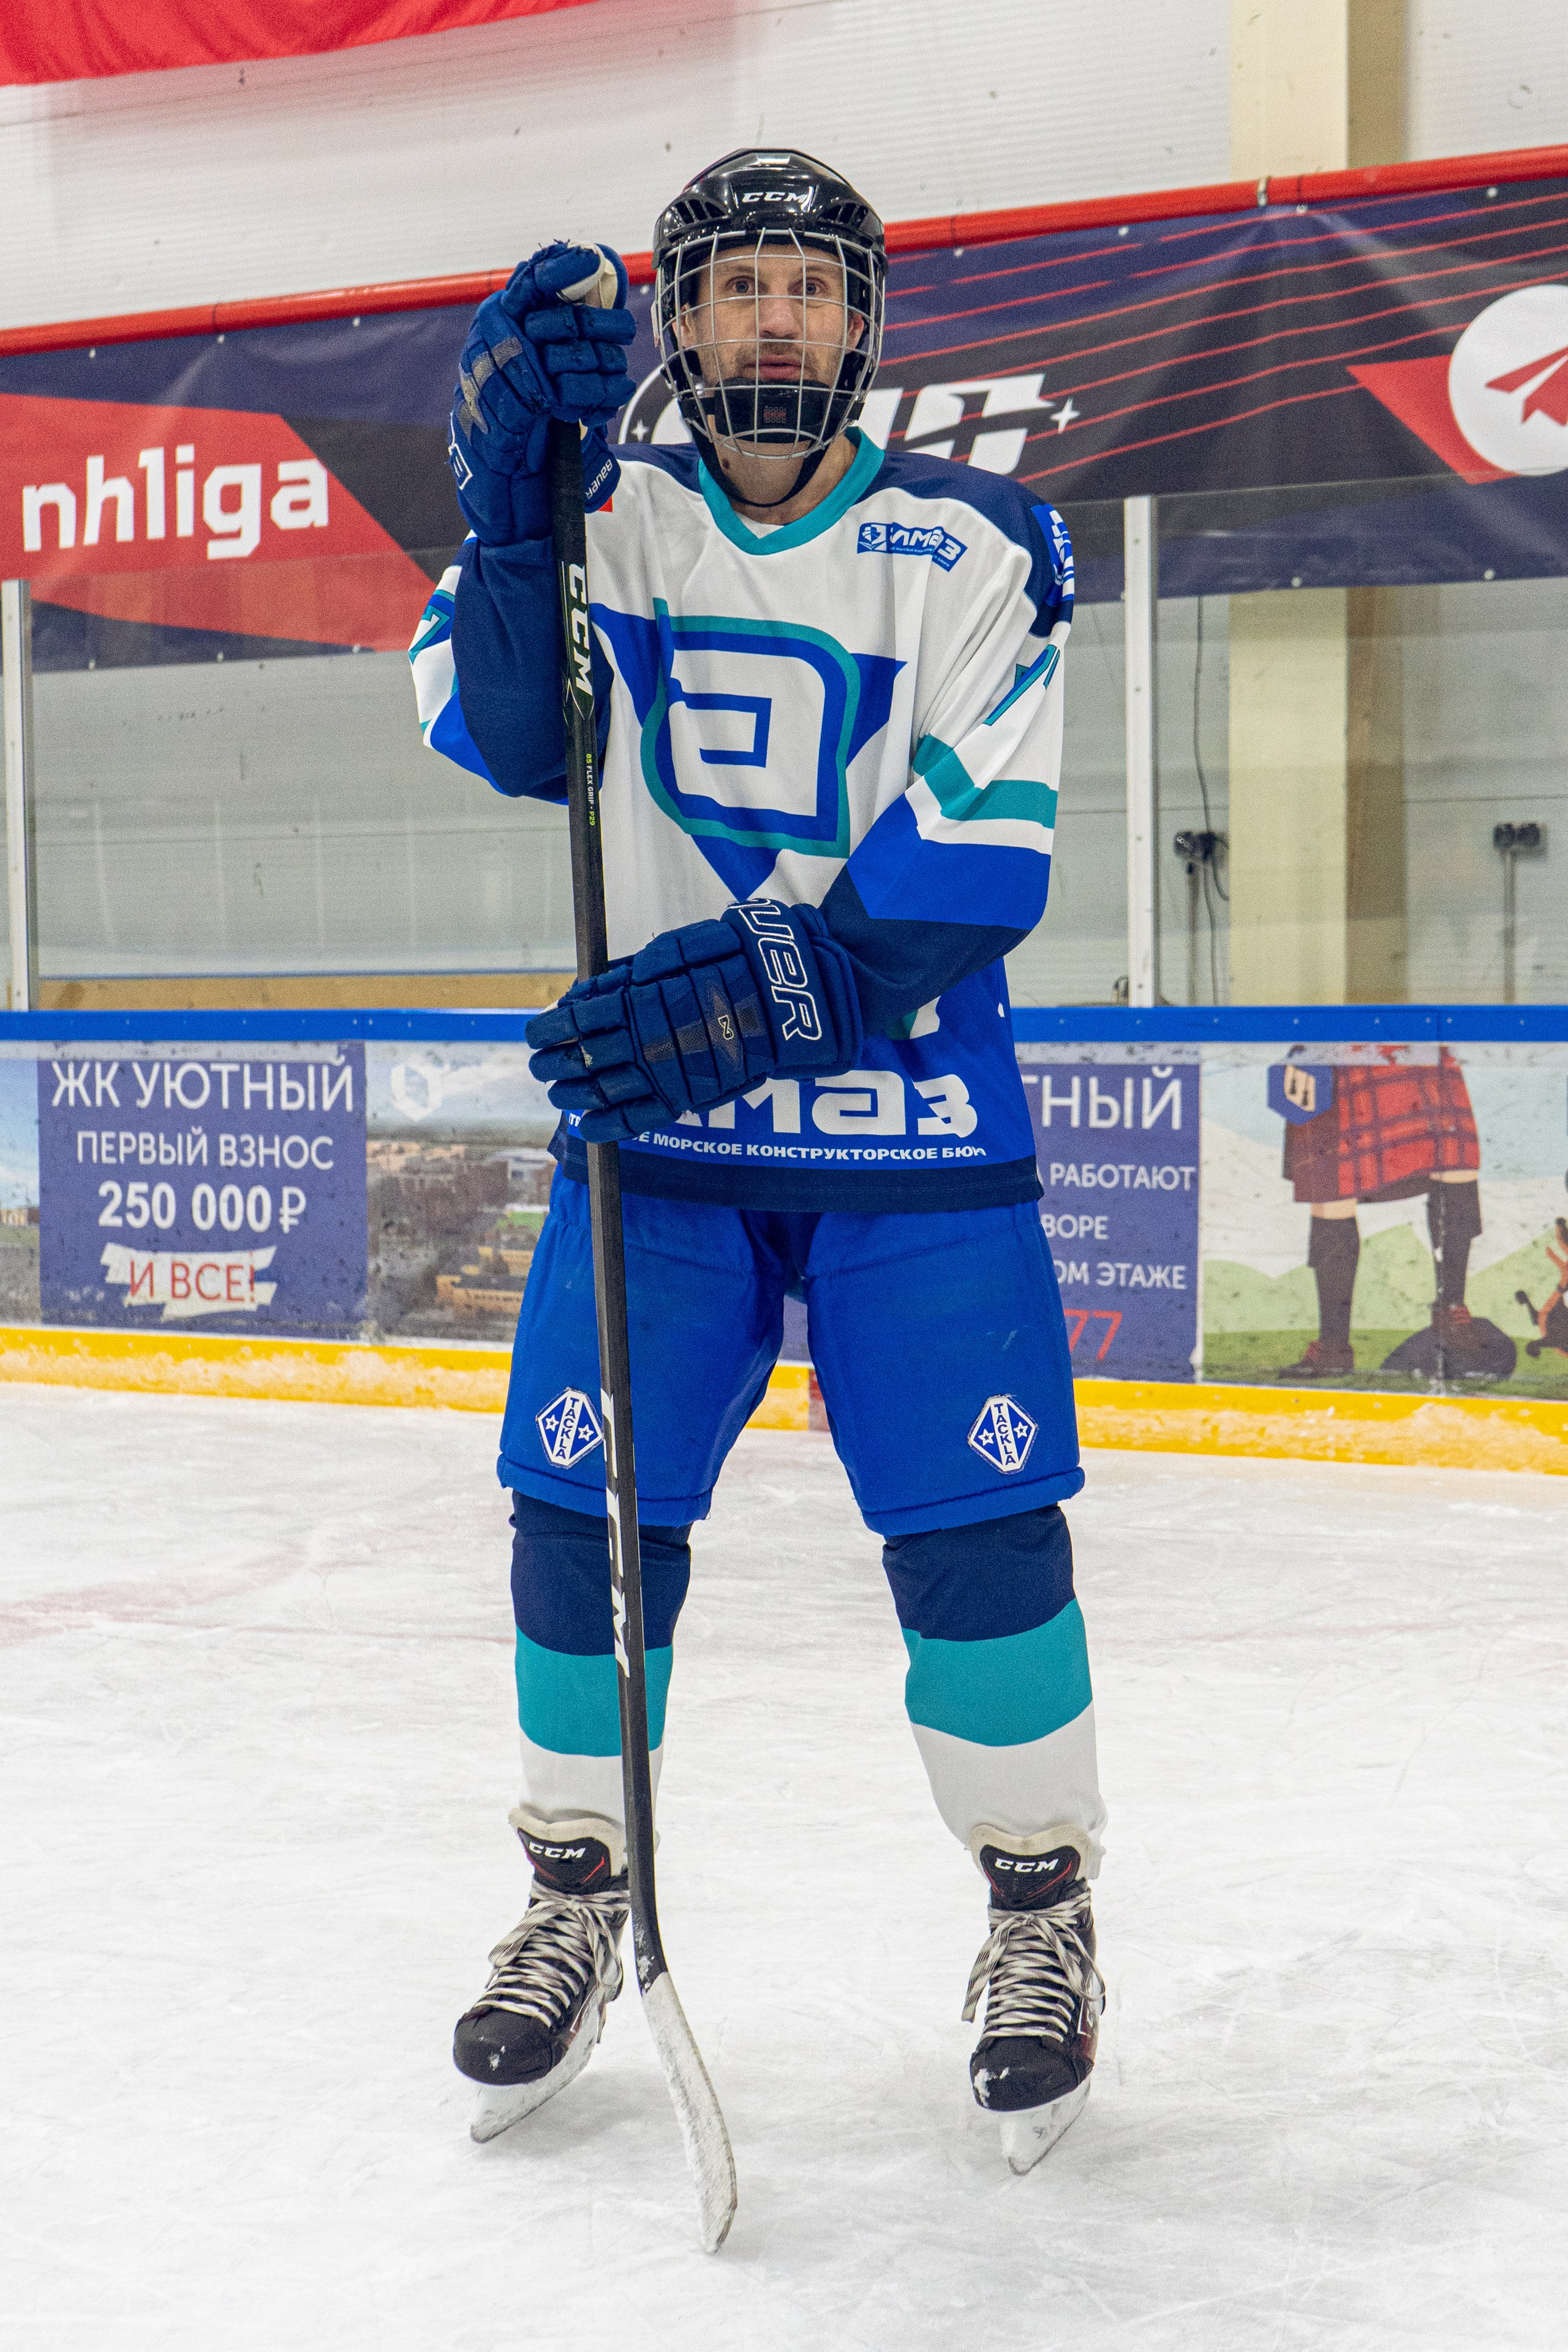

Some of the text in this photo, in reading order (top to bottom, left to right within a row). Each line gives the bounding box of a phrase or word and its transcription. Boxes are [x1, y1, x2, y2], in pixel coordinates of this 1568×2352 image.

[742, 192, 809, 203] CCM
[569, 564, 592, 696] CCM
[729, 898, 822, 1041] UER
[51, 1055, 353, 1112] ЖК УЮТНЫЙ
[77, 1126, 334, 1170] ПЕРВЫЙ ВЗНОС
[653, 1133, 742, 1155] МОРСКОЕ
[747, 1144, 938, 1160] КОНСТРУКТОРСКОЕ
[1050, 1163, 1196, 1191] РАБОТАЮТ
[98, 1180, 176, 1229] 250
[1041, 1213, 1110, 1240] ВОРЕ
[129, 1253, 255, 1303] И ВСЕ!
[1054, 1260, 1188, 1290] ОМ ЭТАЖЕ
[555, 1397, 579, 1460] TACKLA
[993, 1403, 1017, 1466] TACKLA
[528, 1842, 586, 1859] CCM
[995, 1858, 1059, 1873] CCM
